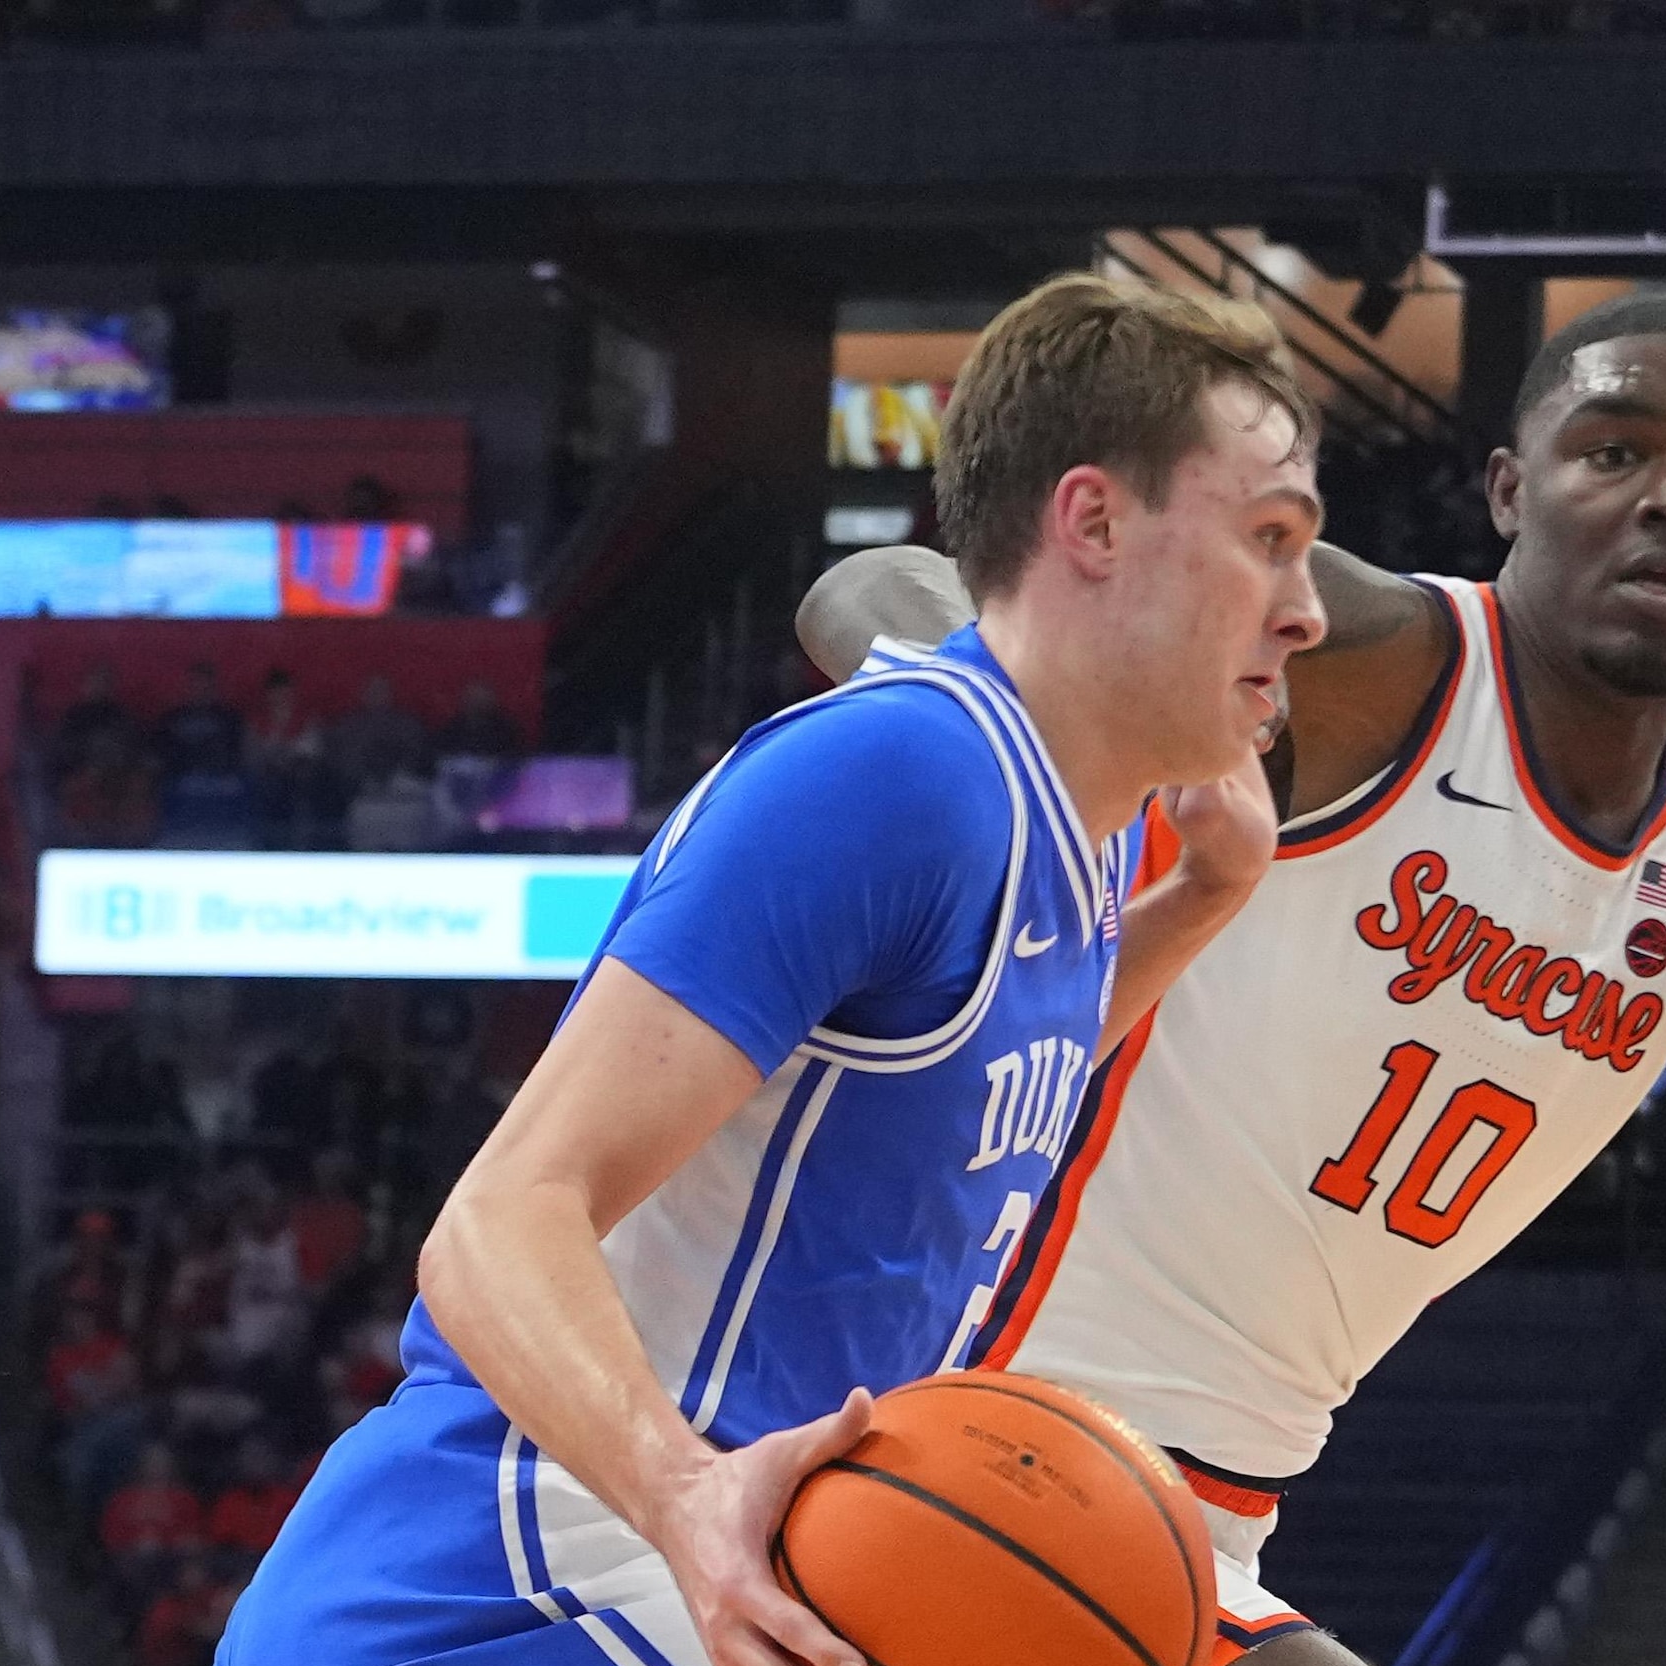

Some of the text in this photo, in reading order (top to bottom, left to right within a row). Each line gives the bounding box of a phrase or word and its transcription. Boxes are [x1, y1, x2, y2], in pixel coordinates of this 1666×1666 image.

[197, 893, 486, 935] Broadview
[1356, 850, 1663, 1073] Syracuse
[965, 1036, 1093, 1181] DUK
[1308, 1039, 1538, 1249] 10
